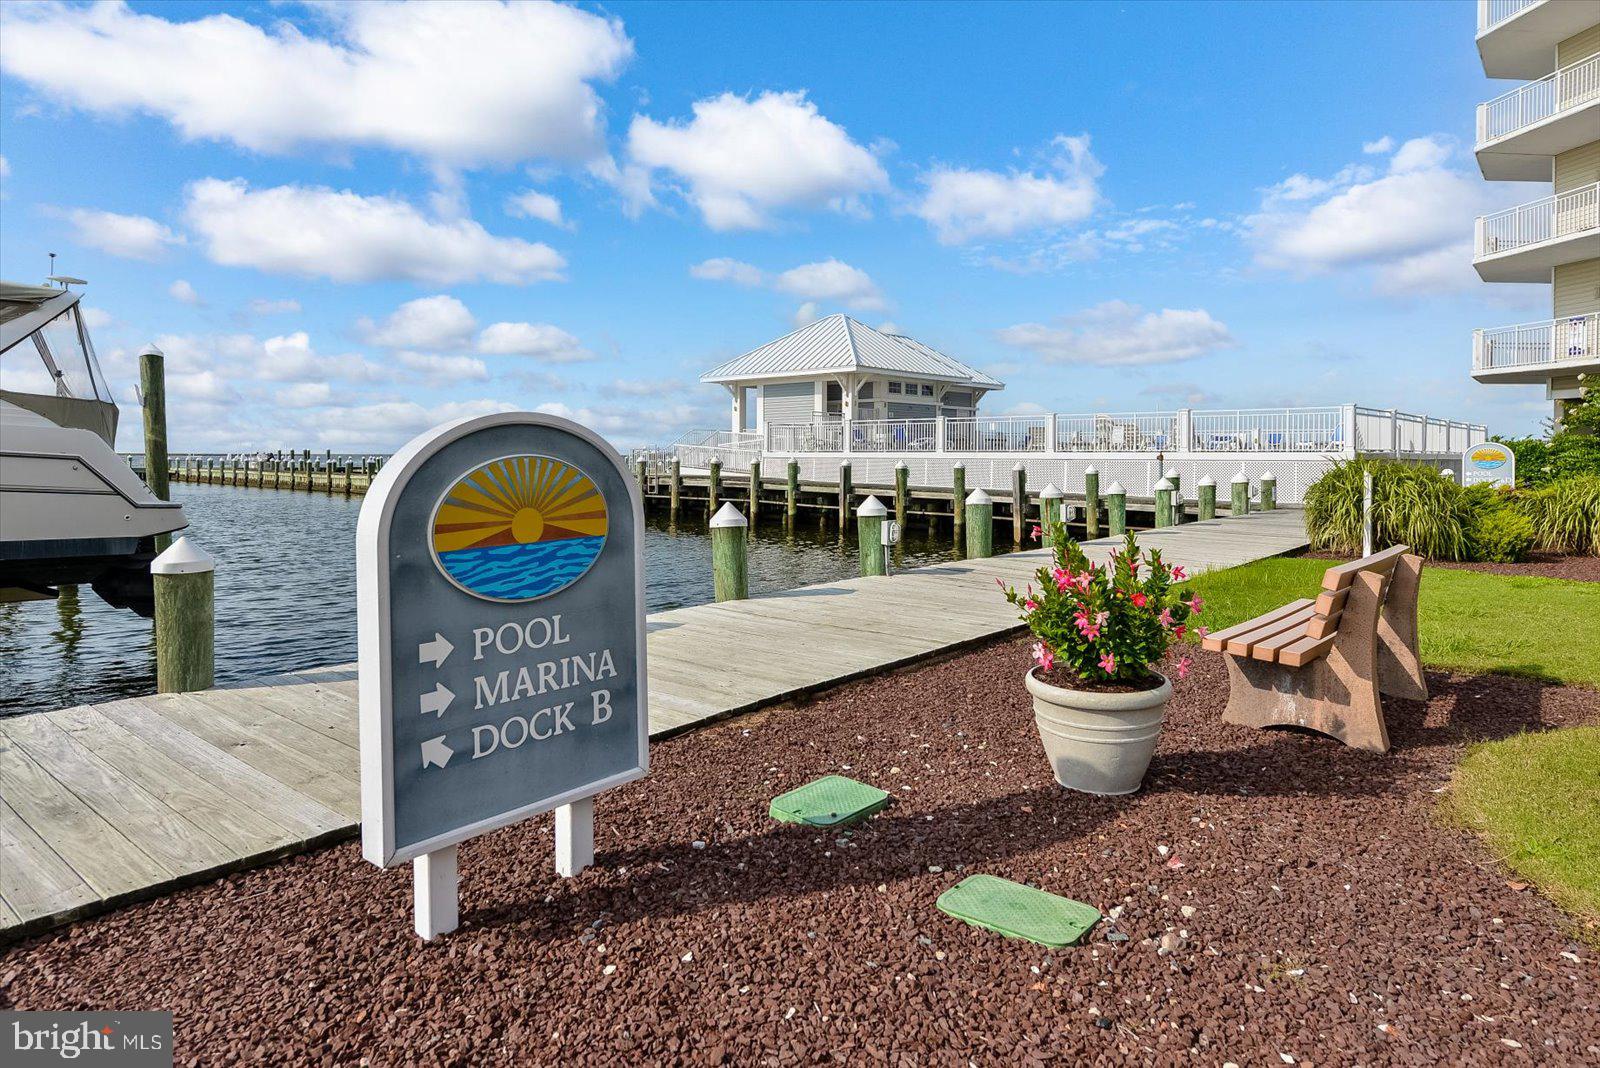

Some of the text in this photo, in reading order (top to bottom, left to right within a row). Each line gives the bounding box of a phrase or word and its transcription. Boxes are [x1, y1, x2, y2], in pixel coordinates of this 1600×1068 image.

[473, 614, 570, 660] POOL
[474, 649, 617, 710] MARINA
[472, 689, 613, 759] DOCK B
